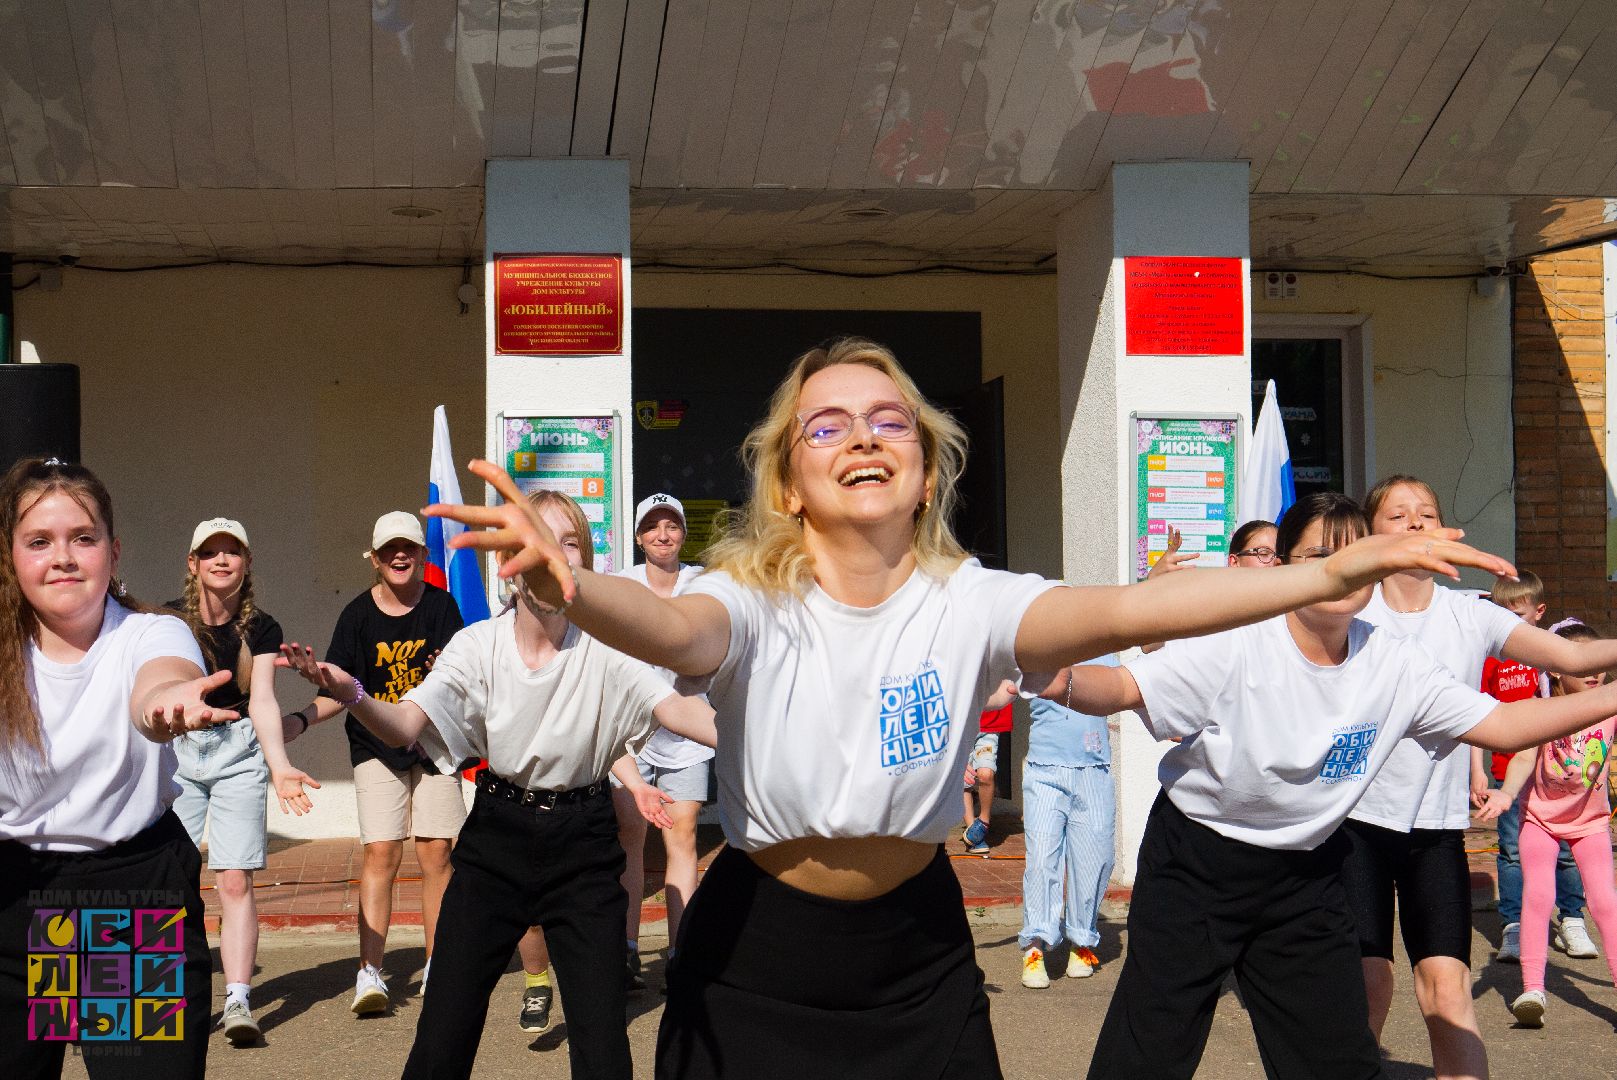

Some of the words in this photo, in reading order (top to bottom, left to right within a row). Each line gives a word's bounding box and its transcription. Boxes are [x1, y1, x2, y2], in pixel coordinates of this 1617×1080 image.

[504, 302, 613, 315] «ЮБИЛЕЙНЫЙ»
[530, 432, 589, 446] ИЮНЬ
[1159, 442, 1214, 455] ИЮНЬ
[522, 454, 530, 467] 5
[587, 480, 598, 494] 8
[375, 639, 426, 667] NOT
[388, 659, 408, 680] IN
[385, 667, 423, 694] THE
